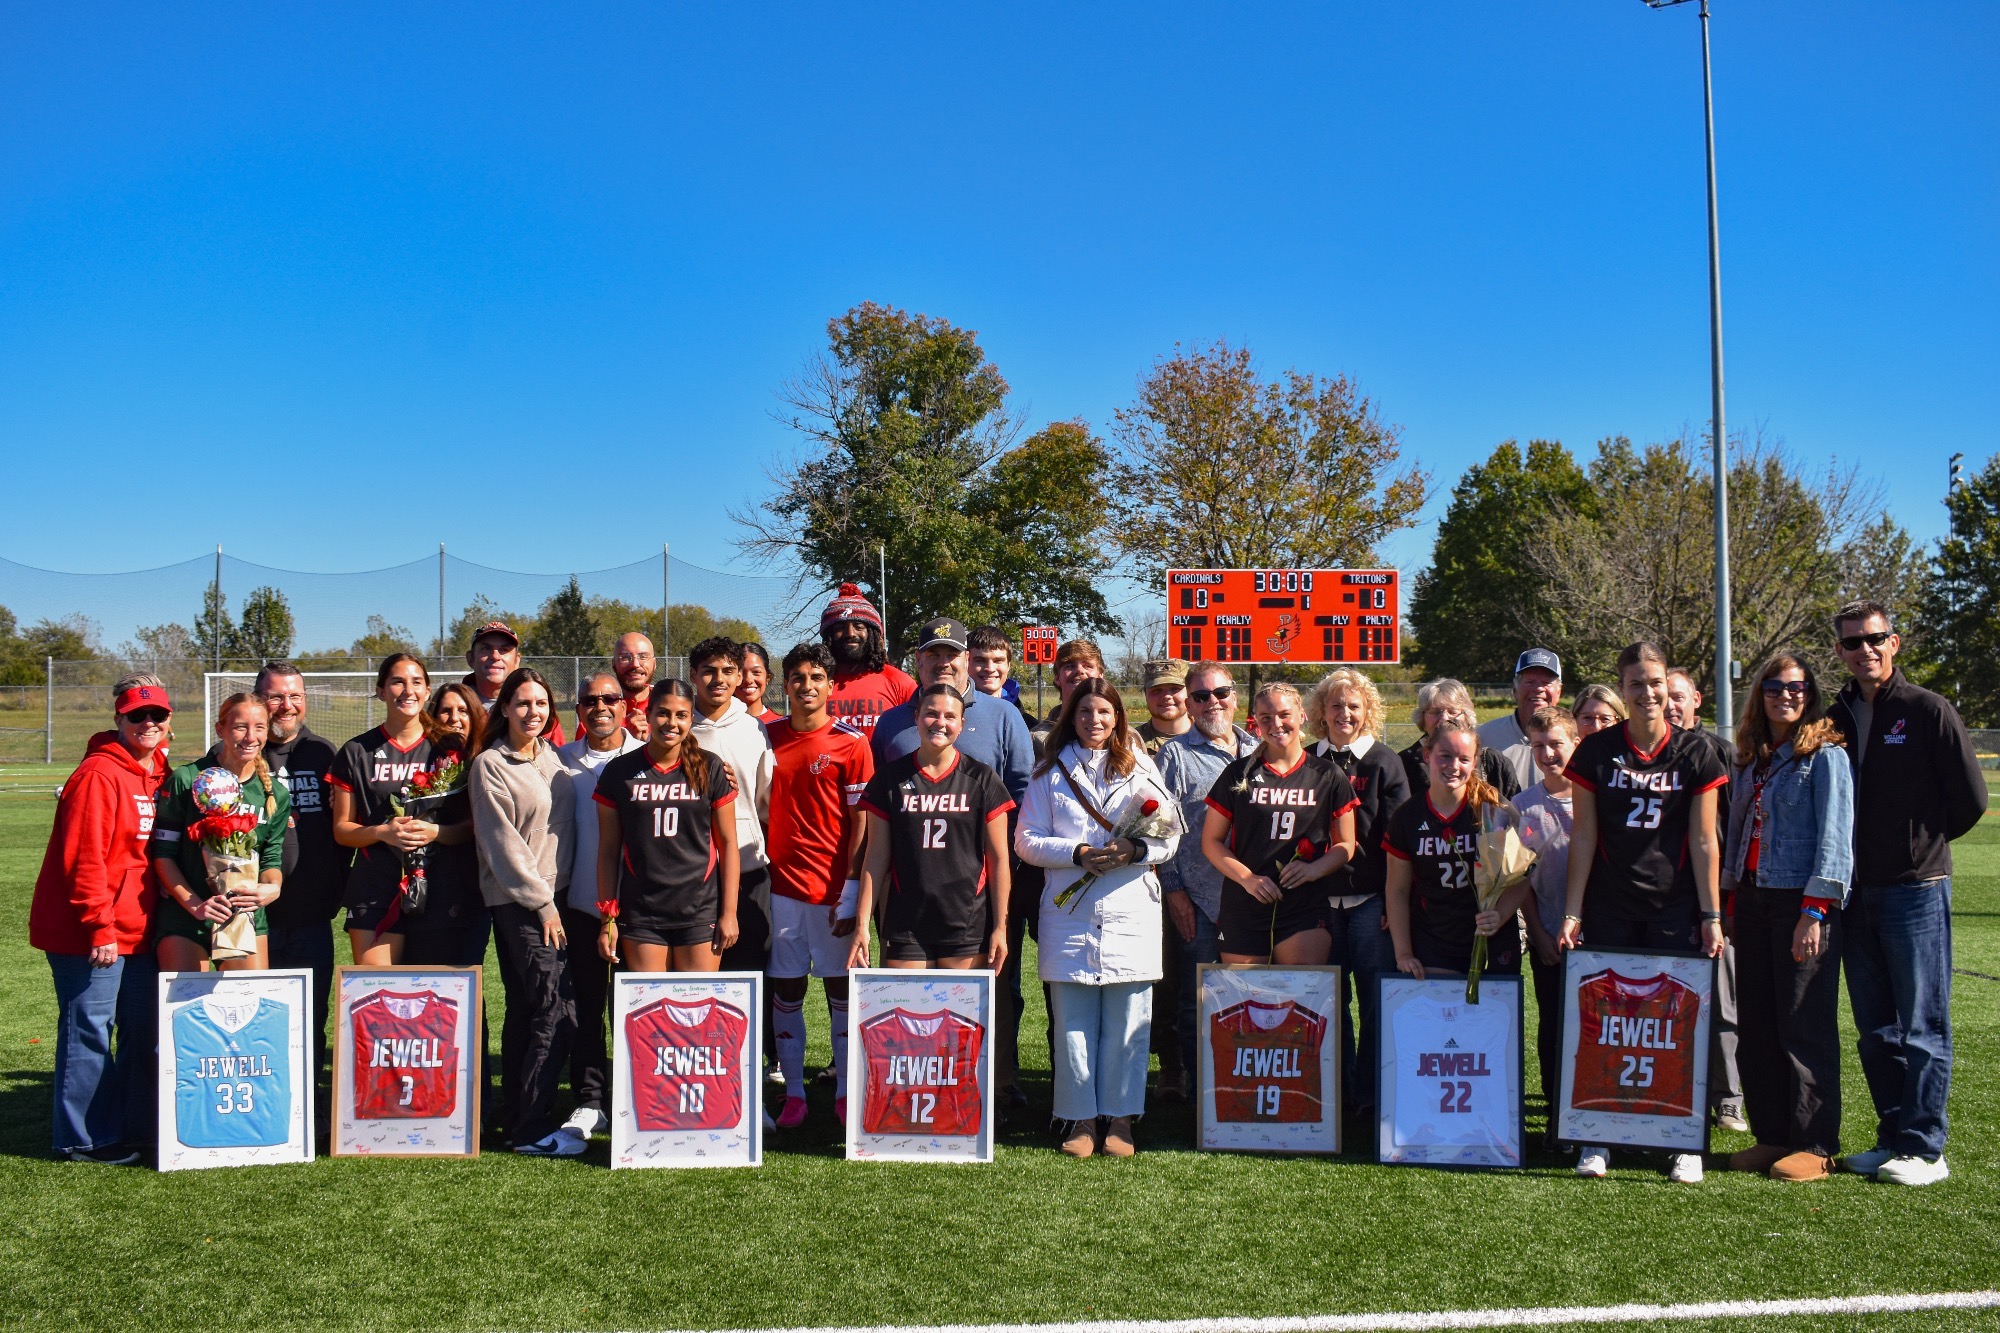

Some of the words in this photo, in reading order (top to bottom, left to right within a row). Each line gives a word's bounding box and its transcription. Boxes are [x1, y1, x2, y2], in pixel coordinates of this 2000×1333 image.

[1175, 574, 1221, 583] CARDINALS
[1256, 572, 1312, 592] 30:00
[1349, 574, 1387, 584] TRITONS
[1196, 588, 1208, 608] 0
[1373, 588, 1385, 608] 0
[1173, 615, 1190, 625] PLY
[1216, 615, 1251, 625] PENALTY
[1332, 615, 1349, 625] PLY
[1365, 615, 1393, 625] PNLTY
[1026, 629, 1055, 639] 30:00
[1028, 641, 1053, 660] 90
[828, 699, 884, 716] EWELL
[1607, 768, 1683, 791] JEWELL
[900, 793, 970, 813] JEWELL
[1249, 787, 1317, 806] JEWELL
[653, 806, 679, 838] 10
[1270, 811, 1296, 840] 19
[1626, 796, 1664, 829] 25
[922, 818, 948, 849] 12
[1438, 861, 1469, 889] 22
[1597, 1014, 1677, 1050] JEWELL
[369, 1038, 443, 1068] JEWELL
[653, 1046, 727, 1076] JEWELL
[1232, 1047, 1302, 1078] JEWELL
[1416, 1053, 1491, 1077] JEWELL
[195, 1054, 273, 1079] JEWELL
[885, 1055, 958, 1086] JEWELL
[1619, 1055, 1655, 1088] 25
[215, 1081, 254, 1114] 33
[398, 1075, 414, 1106] 3
[679, 1083, 705, 1113] 10
[1256, 1084, 1281, 1116] 19
[1440, 1081, 1472, 1113] 22
[911, 1093, 936, 1124] 12
